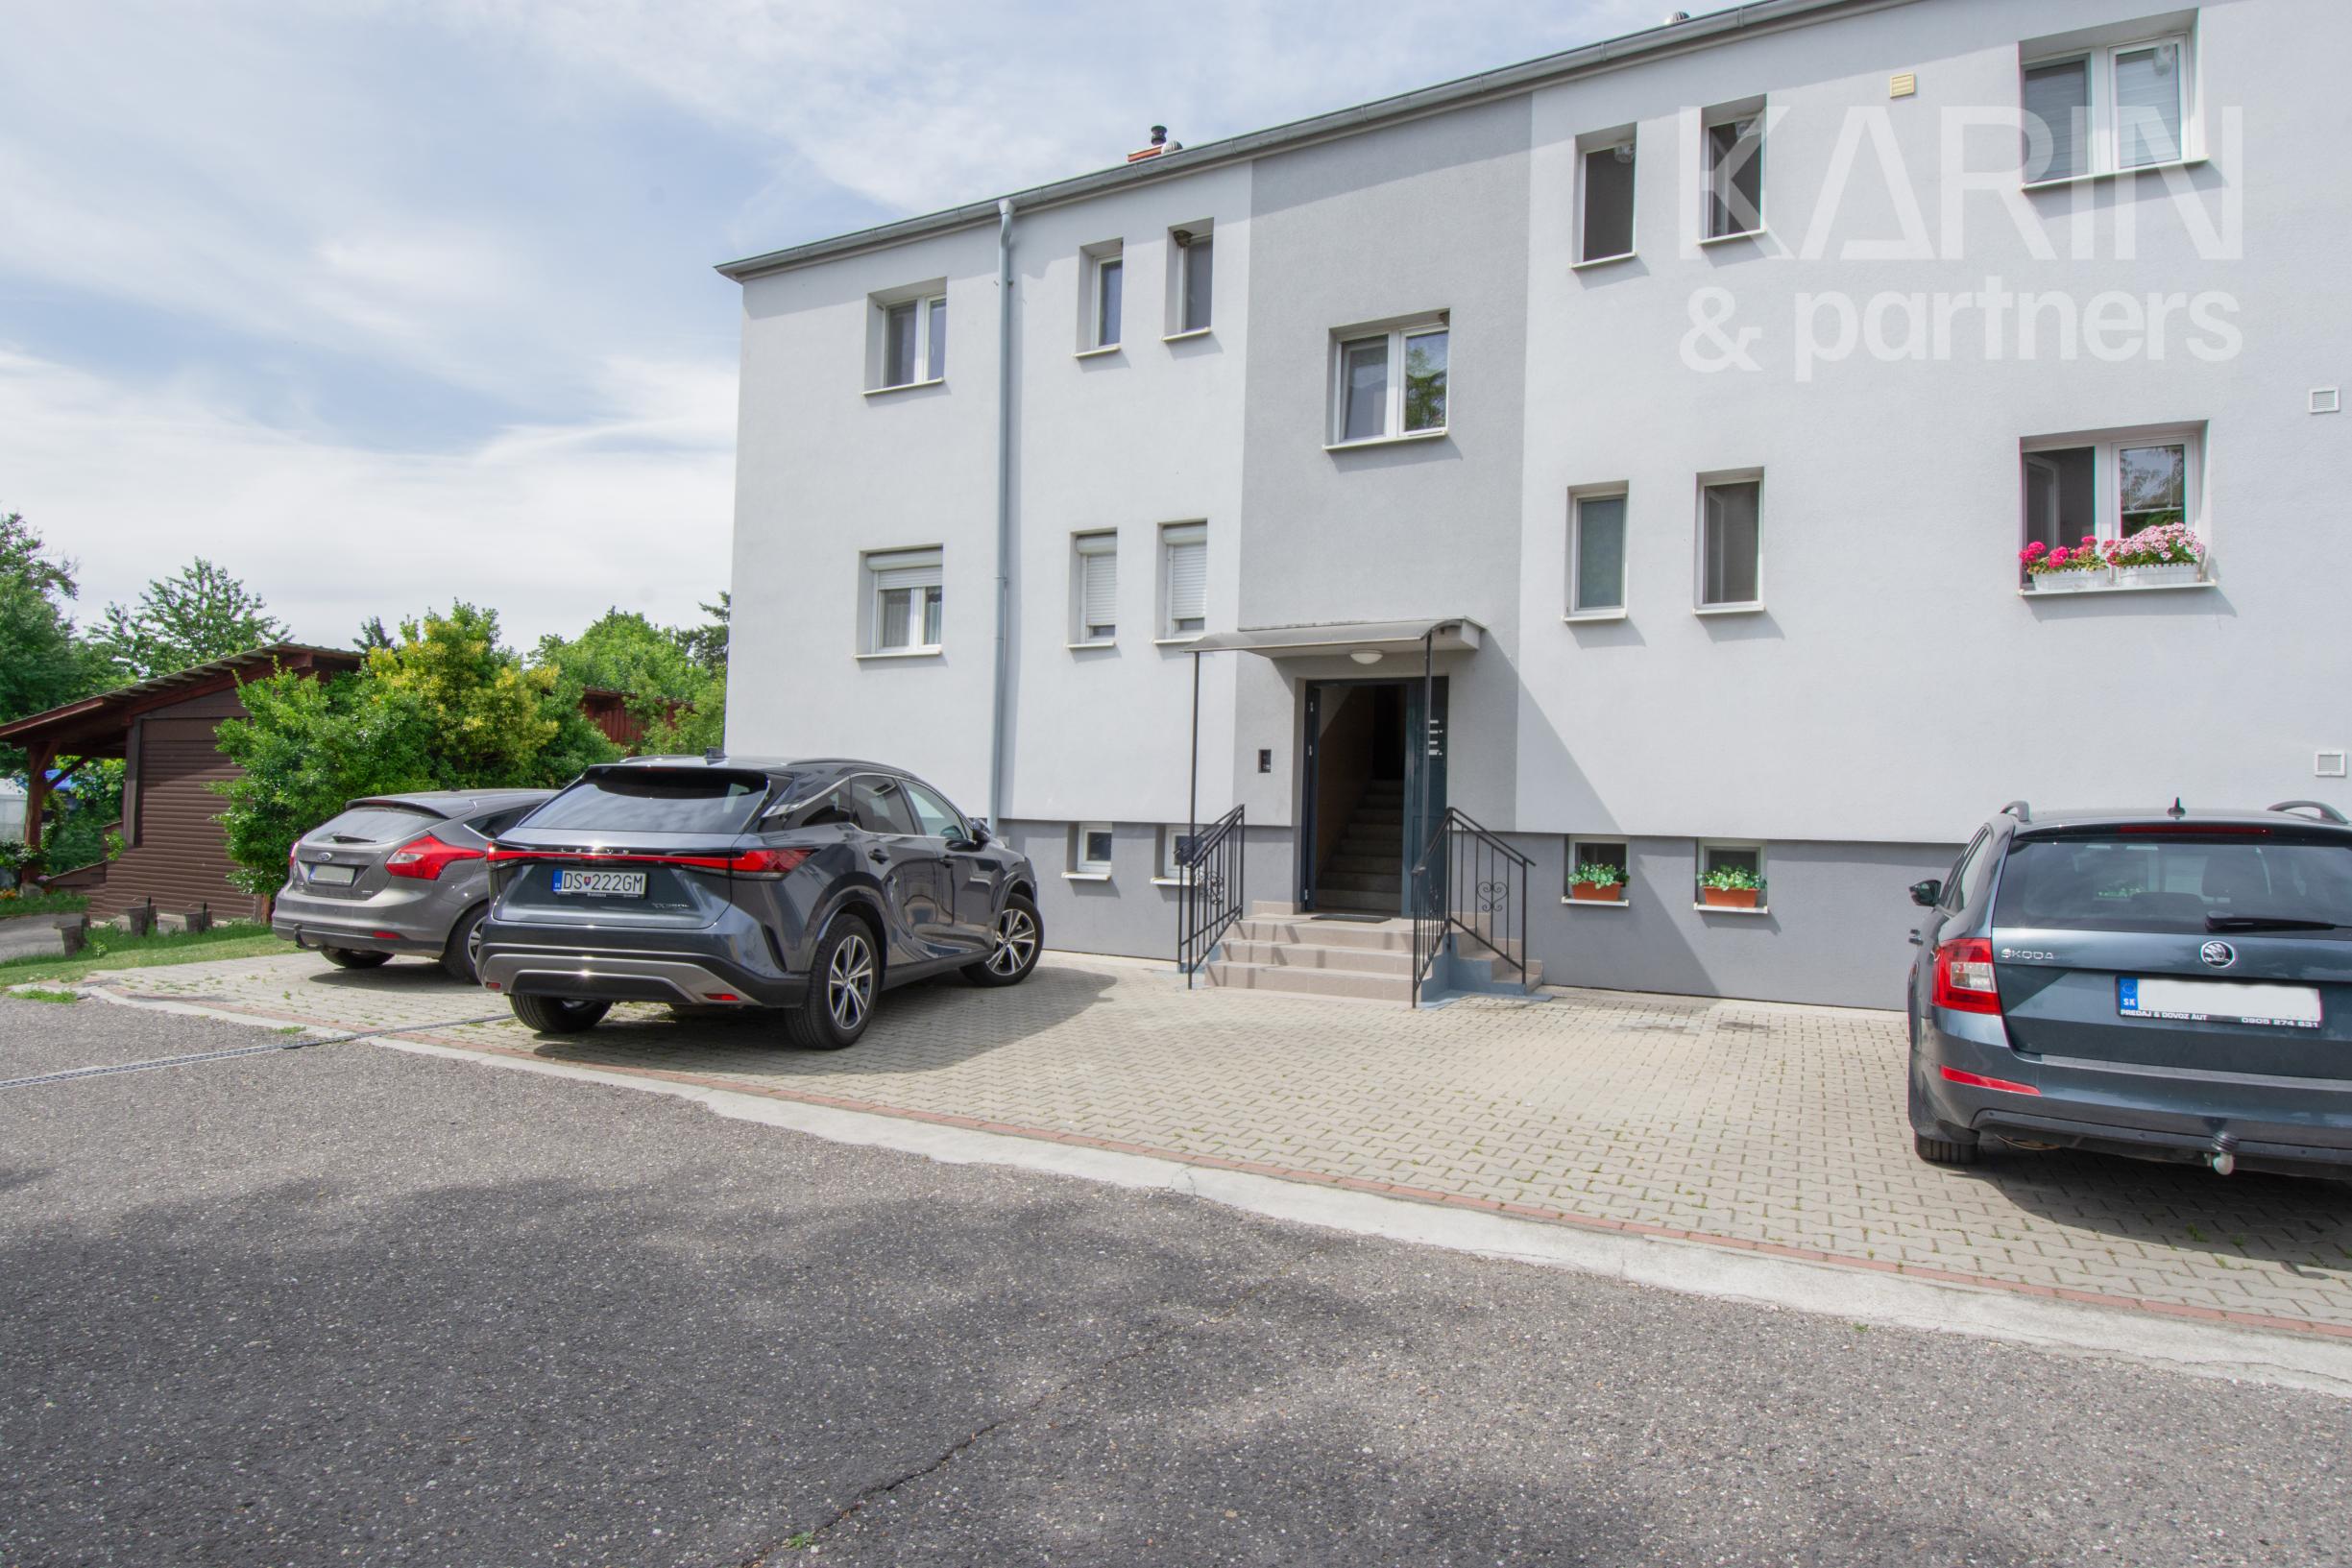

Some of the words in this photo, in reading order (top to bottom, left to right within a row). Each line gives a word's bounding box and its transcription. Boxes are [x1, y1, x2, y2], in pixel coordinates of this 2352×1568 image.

[2122, 998, 2136, 1006] SK
[2121, 1009, 2152, 1018] PREDAJ
[2161, 1011, 2190, 1020] DOVOZ
